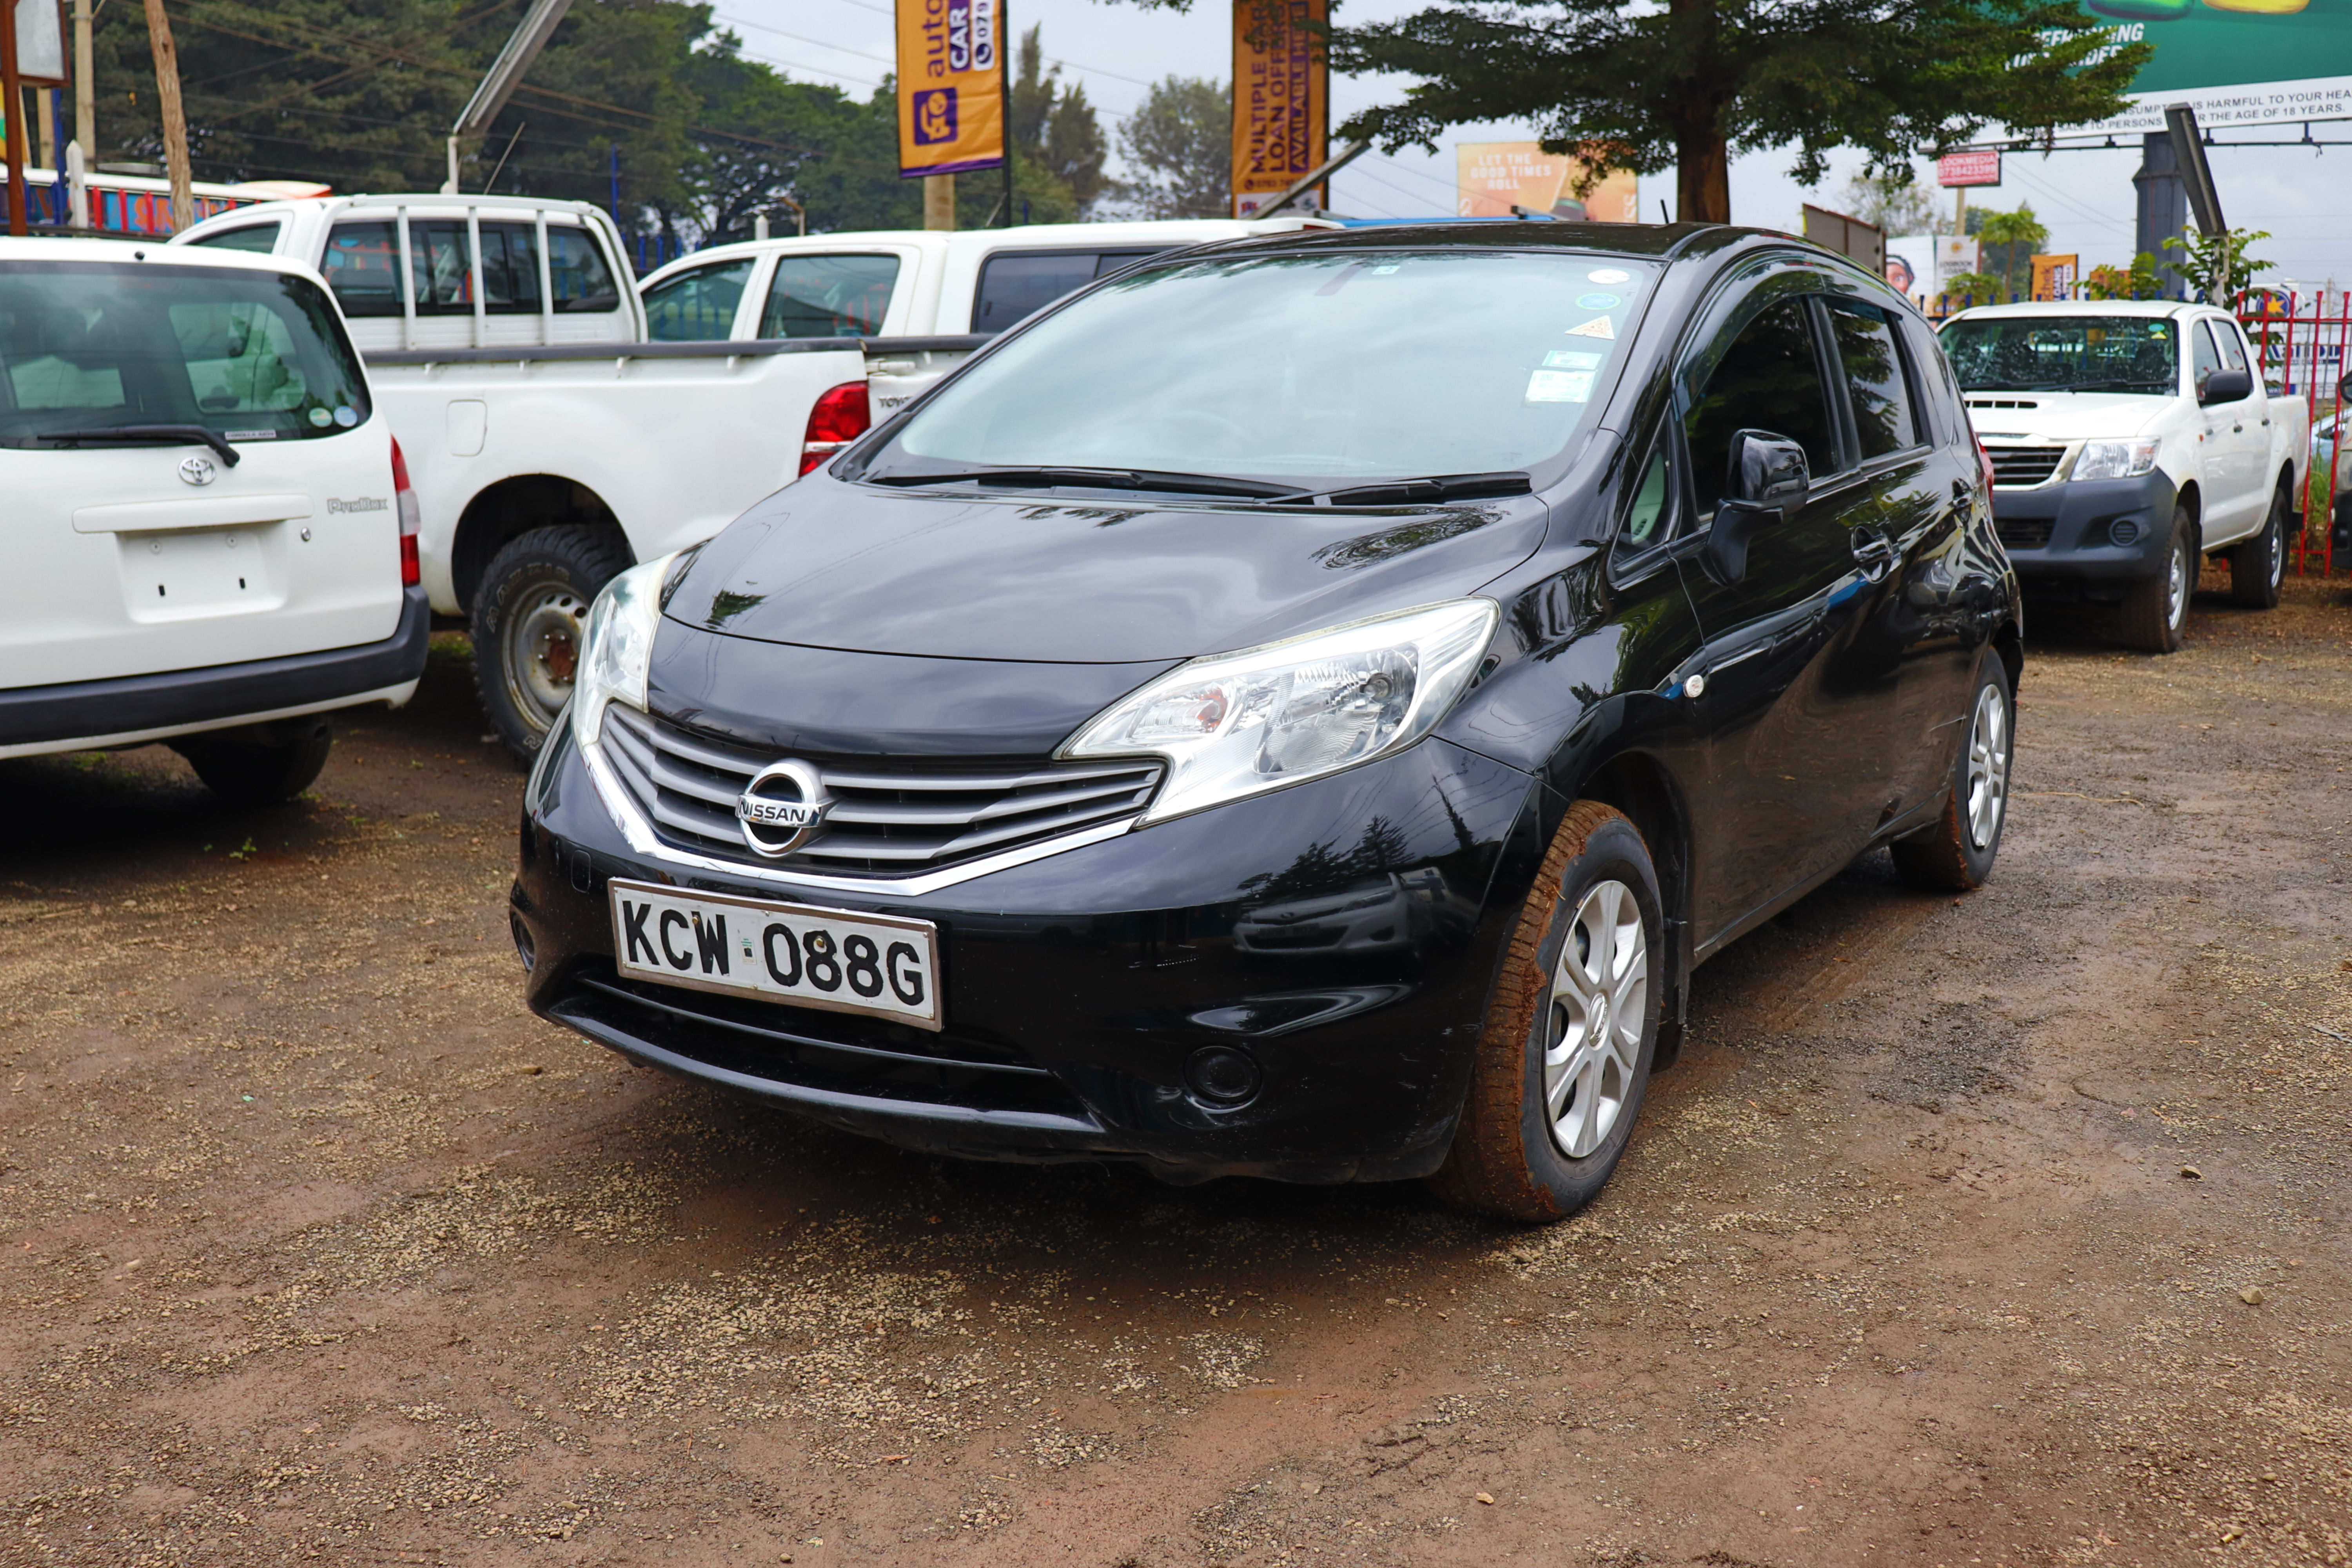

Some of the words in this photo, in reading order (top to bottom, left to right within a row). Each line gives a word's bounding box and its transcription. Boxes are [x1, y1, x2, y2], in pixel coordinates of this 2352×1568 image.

[949, 6, 970, 69] CAR
[2207, 96, 2264, 108] HARMFUL
[2268, 94, 2284, 104] TO
[2288, 91, 2322, 102] YOUR
[1251, 62, 1267, 173] MULTIPLE
[1291, 62, 1306, 169] AVAILABLE
[2210, 112, 2232, 122] THE
[2234, 110, 2259, 120] AGE
[2263, 108, 2279, 117] OF
[2284, 107, 2296, 116] 18
[2300, 103, 2345, 114] YEARS.
[2090, 120, 2105, 130] TO
[2108, 116, 2163, 129] PERSONS
[1270, 106, 1285, 172] LOAN
[1478, 154, 1502, 165] LET
[1507, 153, 1531, 165] THE
[1471, 166, 1506, 178] GOOD
[1511, 165, 1552, 176] TIMES
[1487, 178, 1520, 189] ROLL
[739, 800, 806, 822] NISSAN
[622, 900, 730, 976] KCW
[762, 922, 925, 1006] 088G
